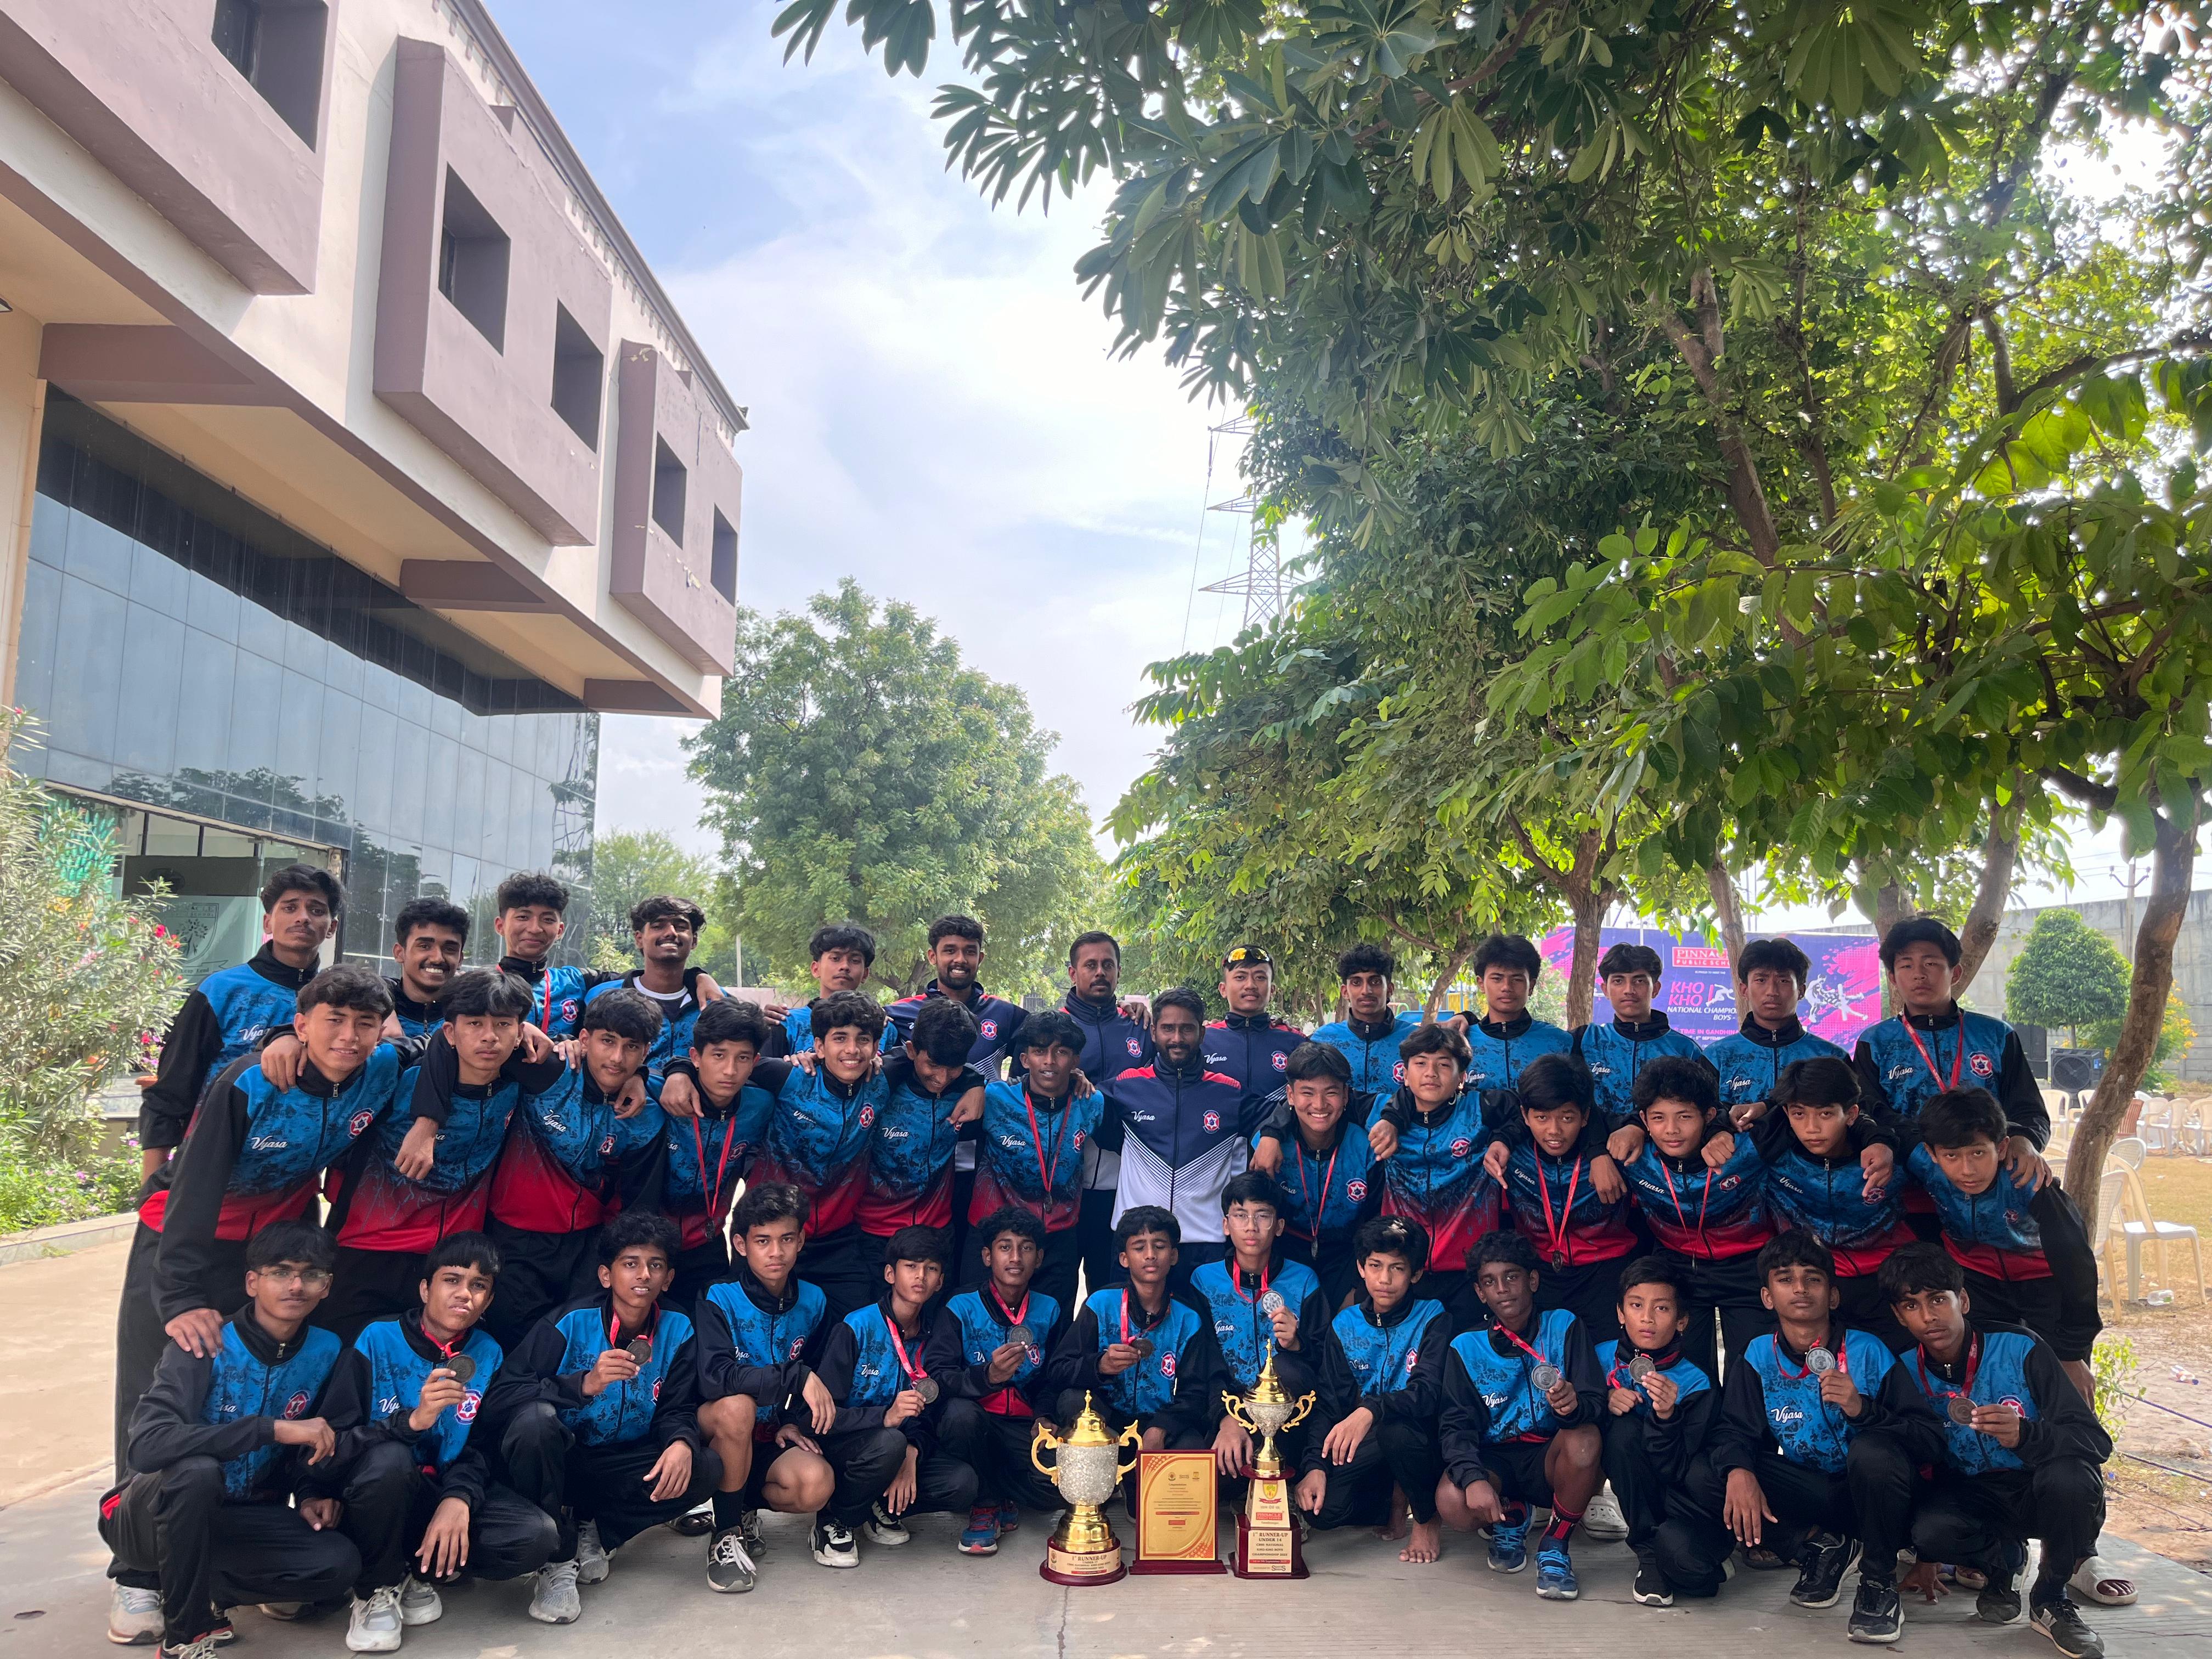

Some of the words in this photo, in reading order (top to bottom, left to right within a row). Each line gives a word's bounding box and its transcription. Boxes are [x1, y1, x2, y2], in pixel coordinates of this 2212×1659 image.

[1671, 981, 1705, 994] KHO
[1668, 994, 1703, 1007] KHO
[1204, 1052, 1228, 1064] Vyasa
[1887, 1064, 1914, 1080] Vyasa
[1725, 1076, 1752, 1091] Vyasa
[543, 1109, 567, 1132] Vyasa
[1131, 1110, 1155, 1122] Vyasa
[882, 1126, 909, 1139] Vyasa
[251, 1135, 288, 1151] Vyasa
[1000, 1135, 1026, 1148] Vyasa
[1779, 1177, 1804, 1194] Vyasa
[1481, 1392, 1509, 1408] Vyasa
[1770, 1406, 1804, 1424] Vyasa
